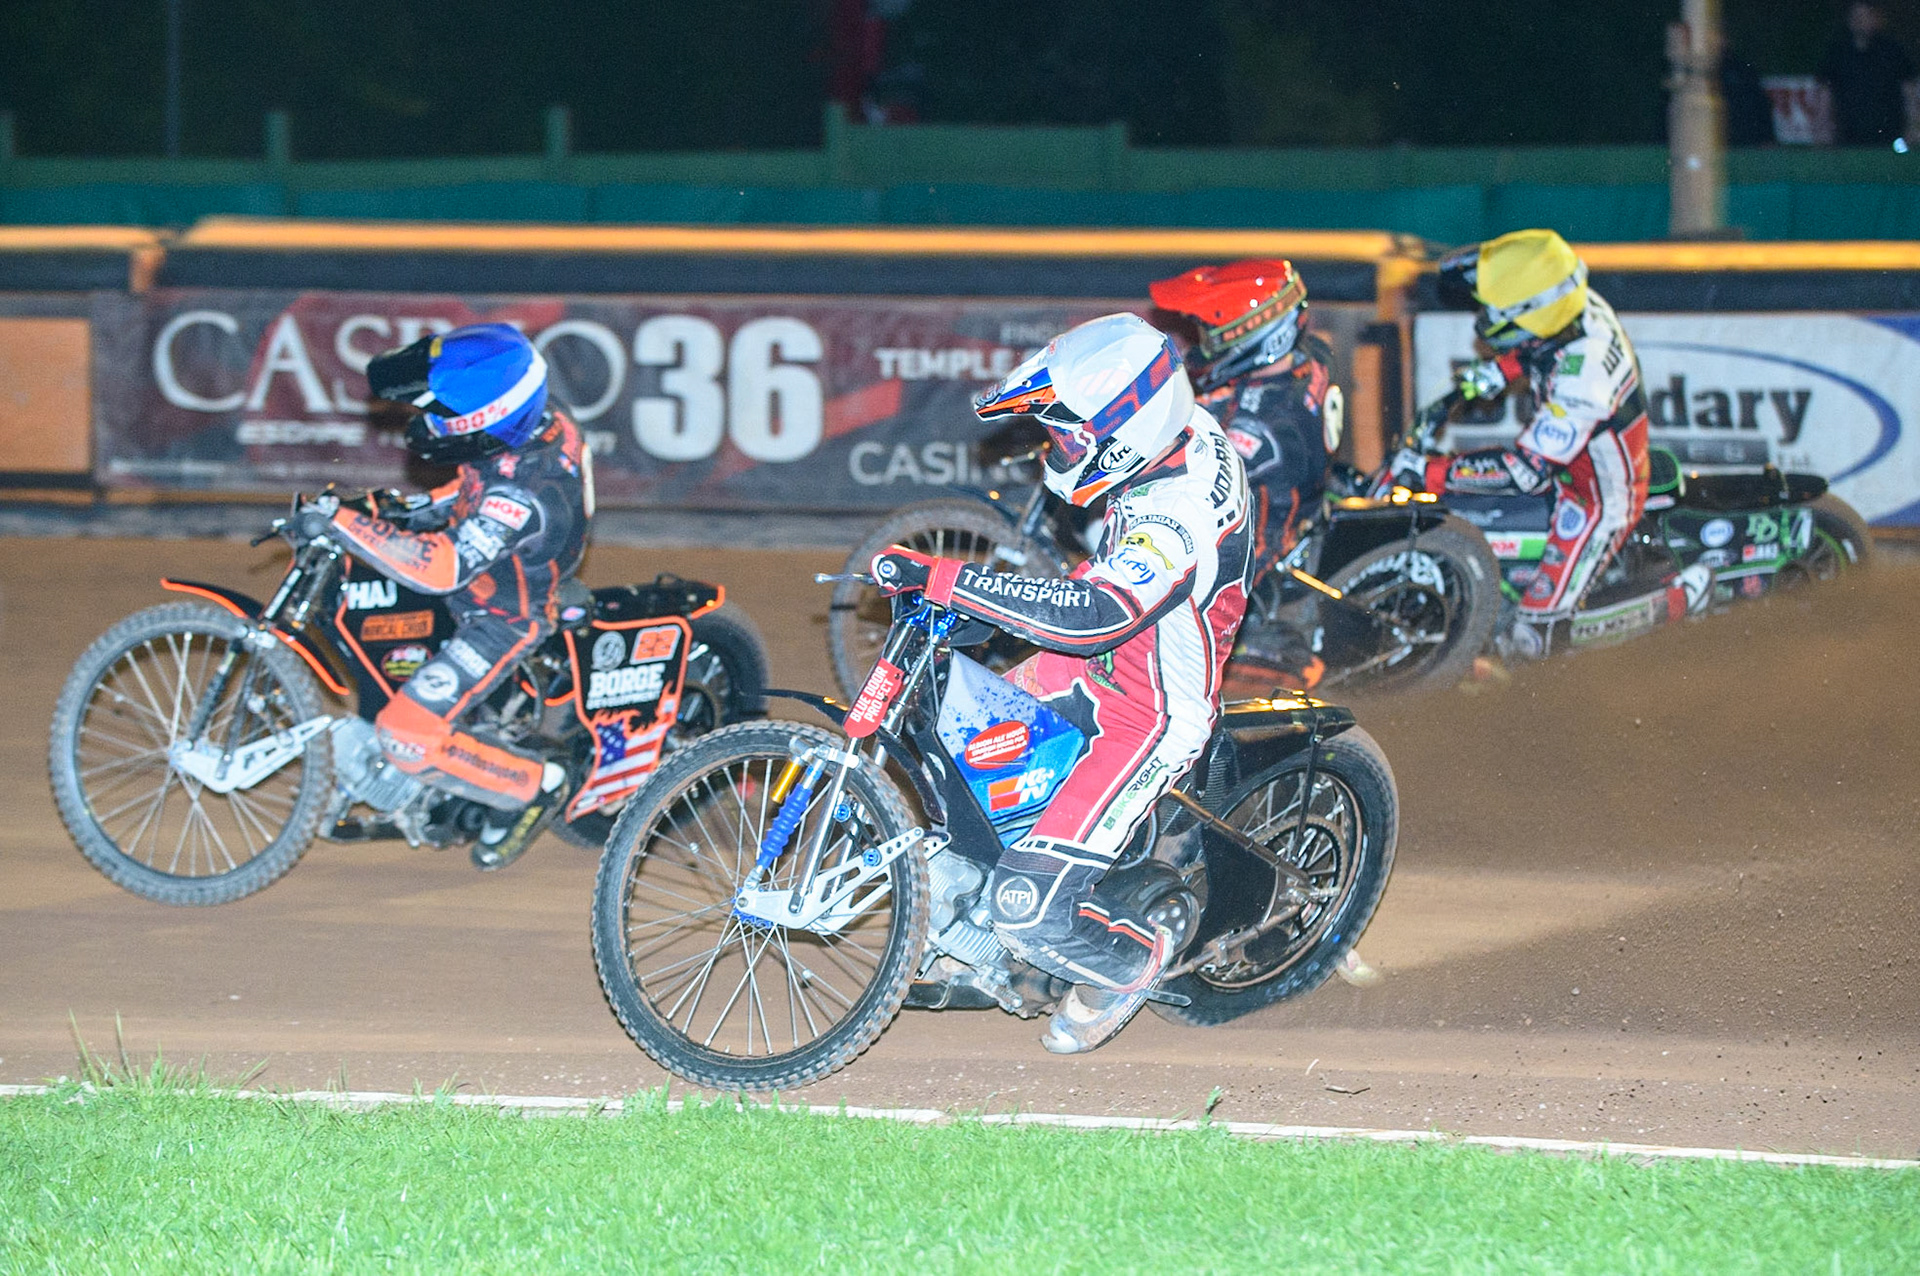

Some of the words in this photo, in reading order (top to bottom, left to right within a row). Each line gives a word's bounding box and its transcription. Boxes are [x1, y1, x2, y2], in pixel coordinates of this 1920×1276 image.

[874, 347, 1014, 381] TEMPLE
[153, 311, 627, 419] CASO
[633, 314, 824, 463] 36
[446, 401, 508, 433] 100%
[849, 441, 1028, 486] CASI
[964, 569, 1091, 607] TRANSPORT
[849, 694, 871, 723] BLUE
[864, 666, 889, 697] DOOR
[1014, 767, 1055, 804] K&N
[1000, 890, 1032, 905] ATPI
